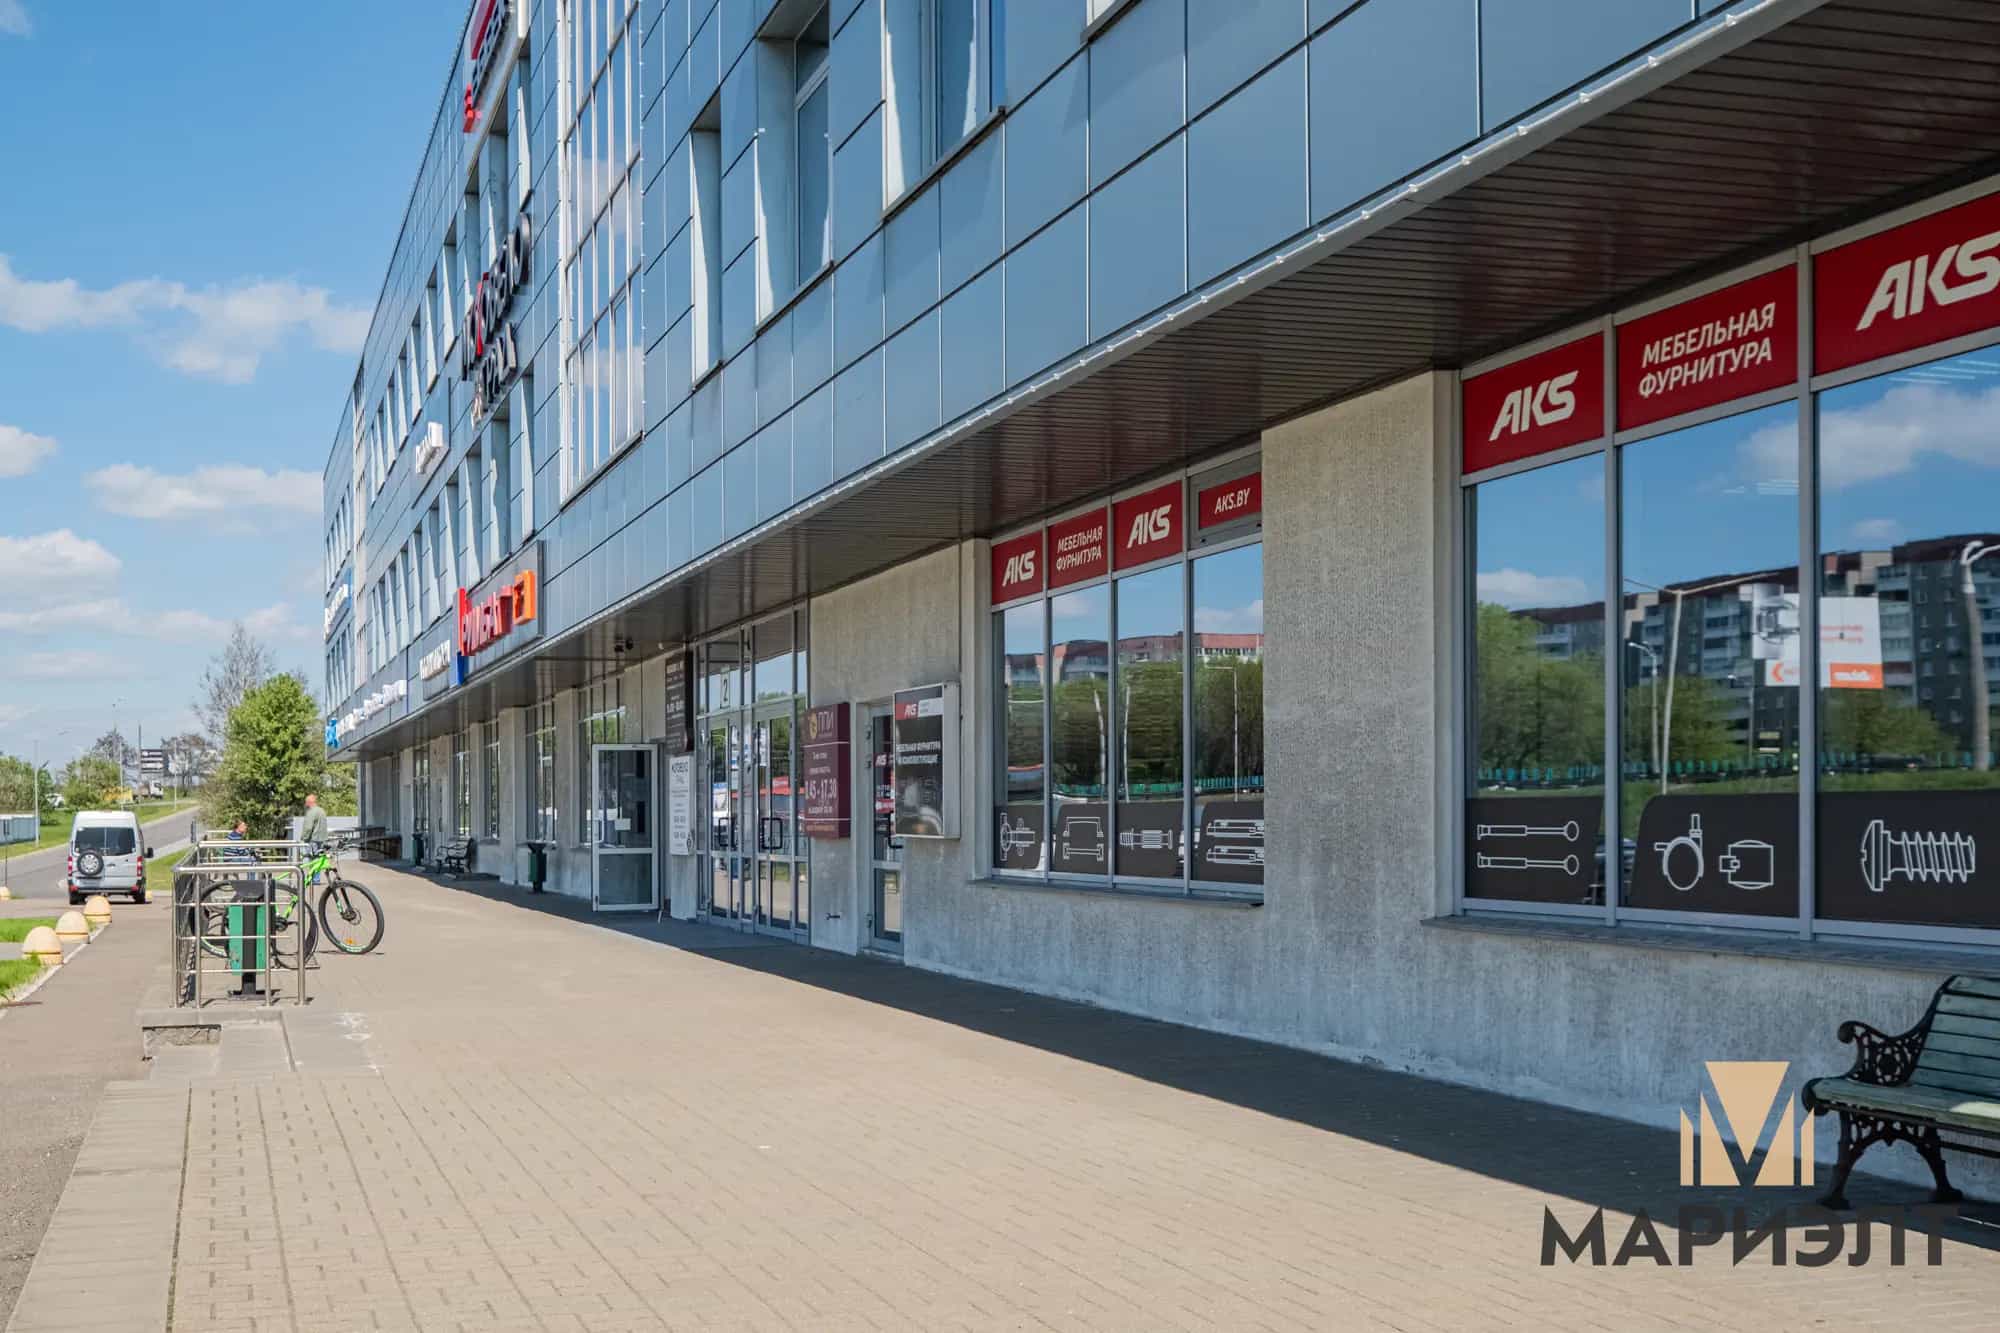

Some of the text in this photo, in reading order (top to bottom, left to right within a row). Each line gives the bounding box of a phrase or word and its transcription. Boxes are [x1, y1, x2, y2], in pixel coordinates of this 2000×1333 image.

[1856, 231, 2000, 331] AKS
[1642, 302, 1776, 368] МЕБЕЛЬНАЯ
[1638, 337, 1773, 398] ФУРНИТУРА
[1489, 370, 1579, 441] AKS
[1215, 488, 1251, 514] AKS.BY
[1057, 525, 1103, 552] МЕБЕЛЬНАЯ
[1127, 503, 1172, 549] AKS
[1002, 550, 1036, 587] AKS
[1056, 545, 1102, 571] ФУРНИТУРА
[723, 678, 728, 702] 2
